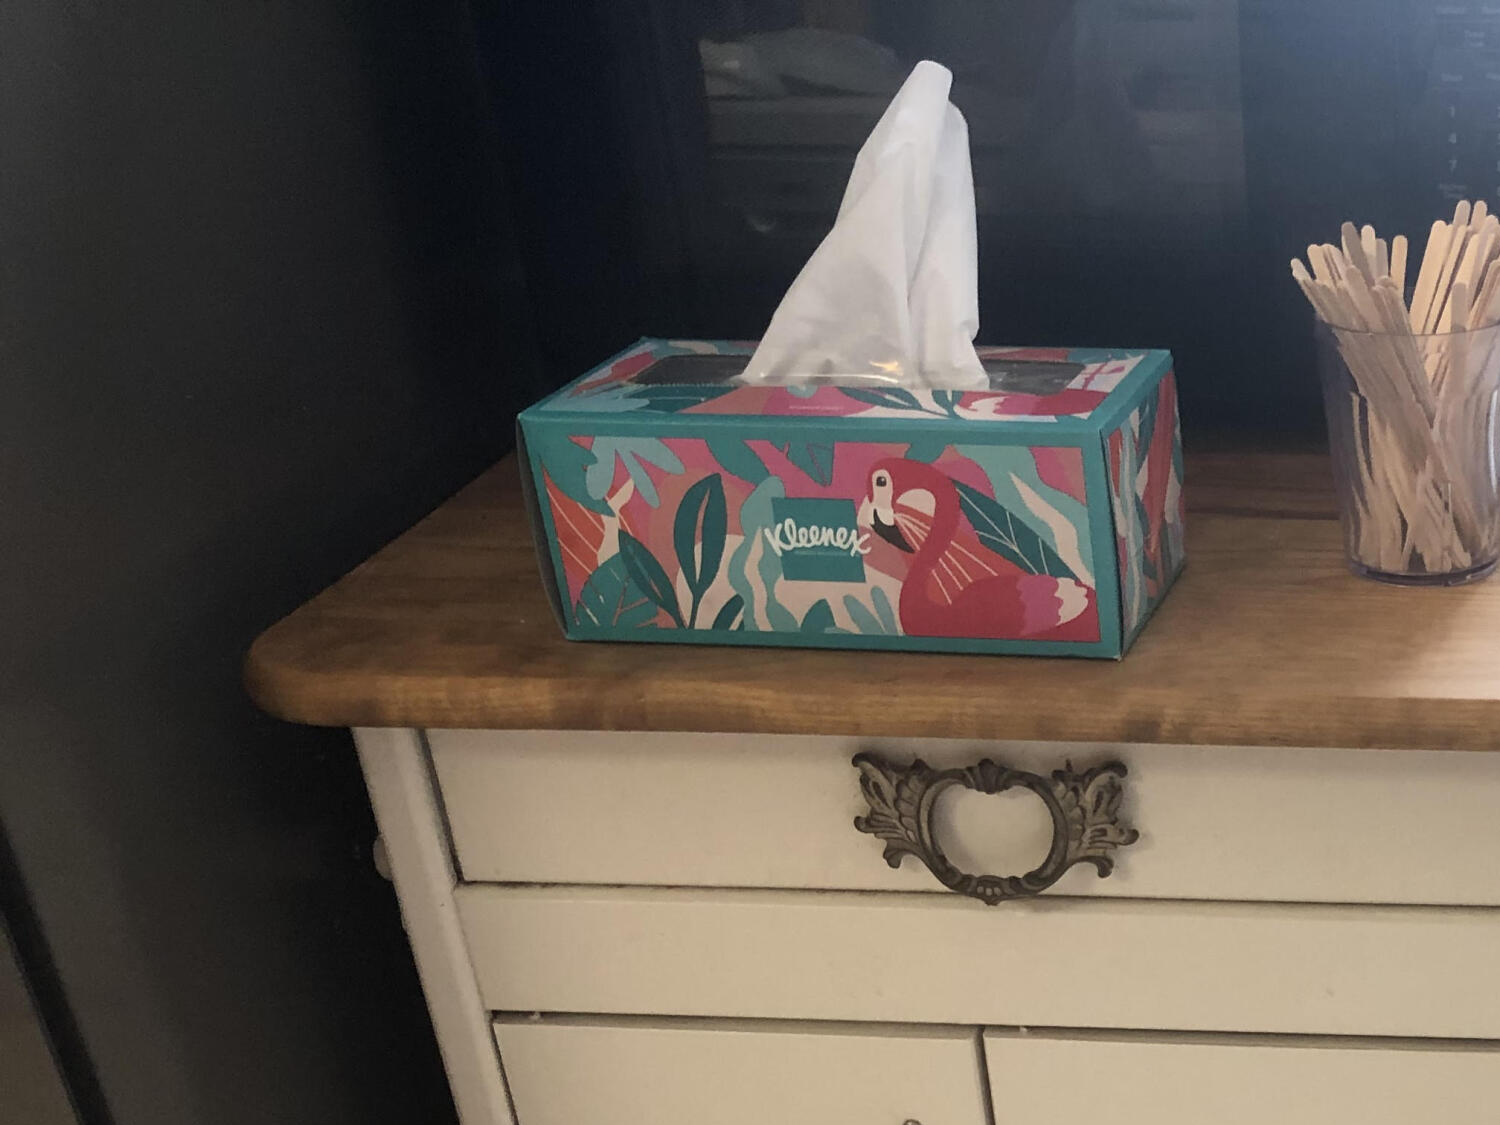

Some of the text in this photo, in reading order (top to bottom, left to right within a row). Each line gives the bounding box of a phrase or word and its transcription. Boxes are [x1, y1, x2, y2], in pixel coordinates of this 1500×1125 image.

[1448, 105, 1456, 118] 1
[1448, 132, 1457, 144] 4
[1448, 159, 1457, 173] 7
[764, 518, 872, 557] Kleenex
